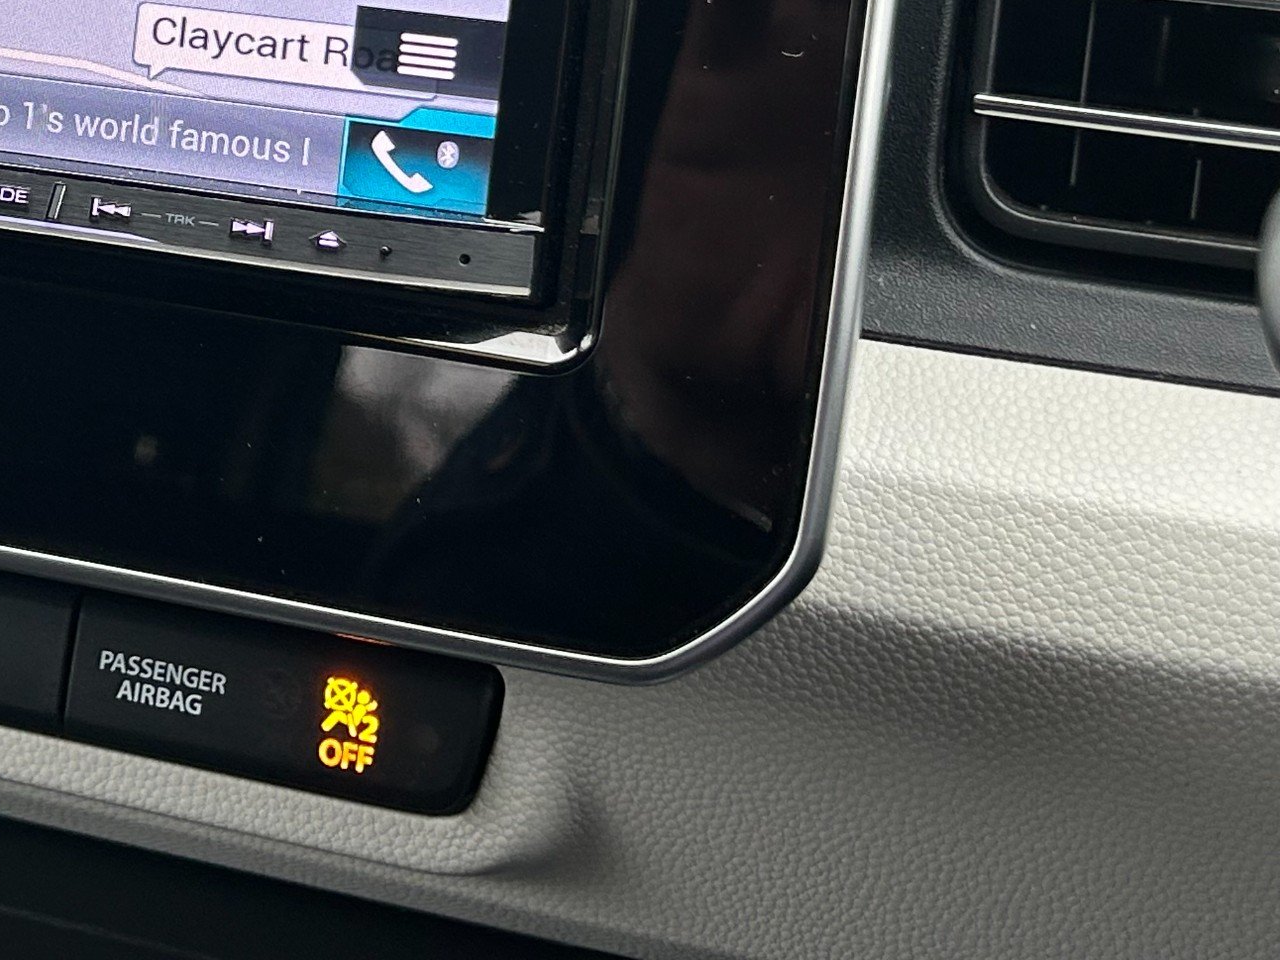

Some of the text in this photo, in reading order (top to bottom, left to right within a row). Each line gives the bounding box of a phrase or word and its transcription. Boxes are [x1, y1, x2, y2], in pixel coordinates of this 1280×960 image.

[152, 16, 310, 62] Claycart
[23, 102, 64, 134] 1's
[75, 113, 159, 146] world
[169, 120, 291, 164] famous
[165, 213, 196, 226] TRK
[99, 650, 227, 695] PASSENGER
[116, 680, 203, 716] AIRBAG
[318, 737, 375, 774] OFF
